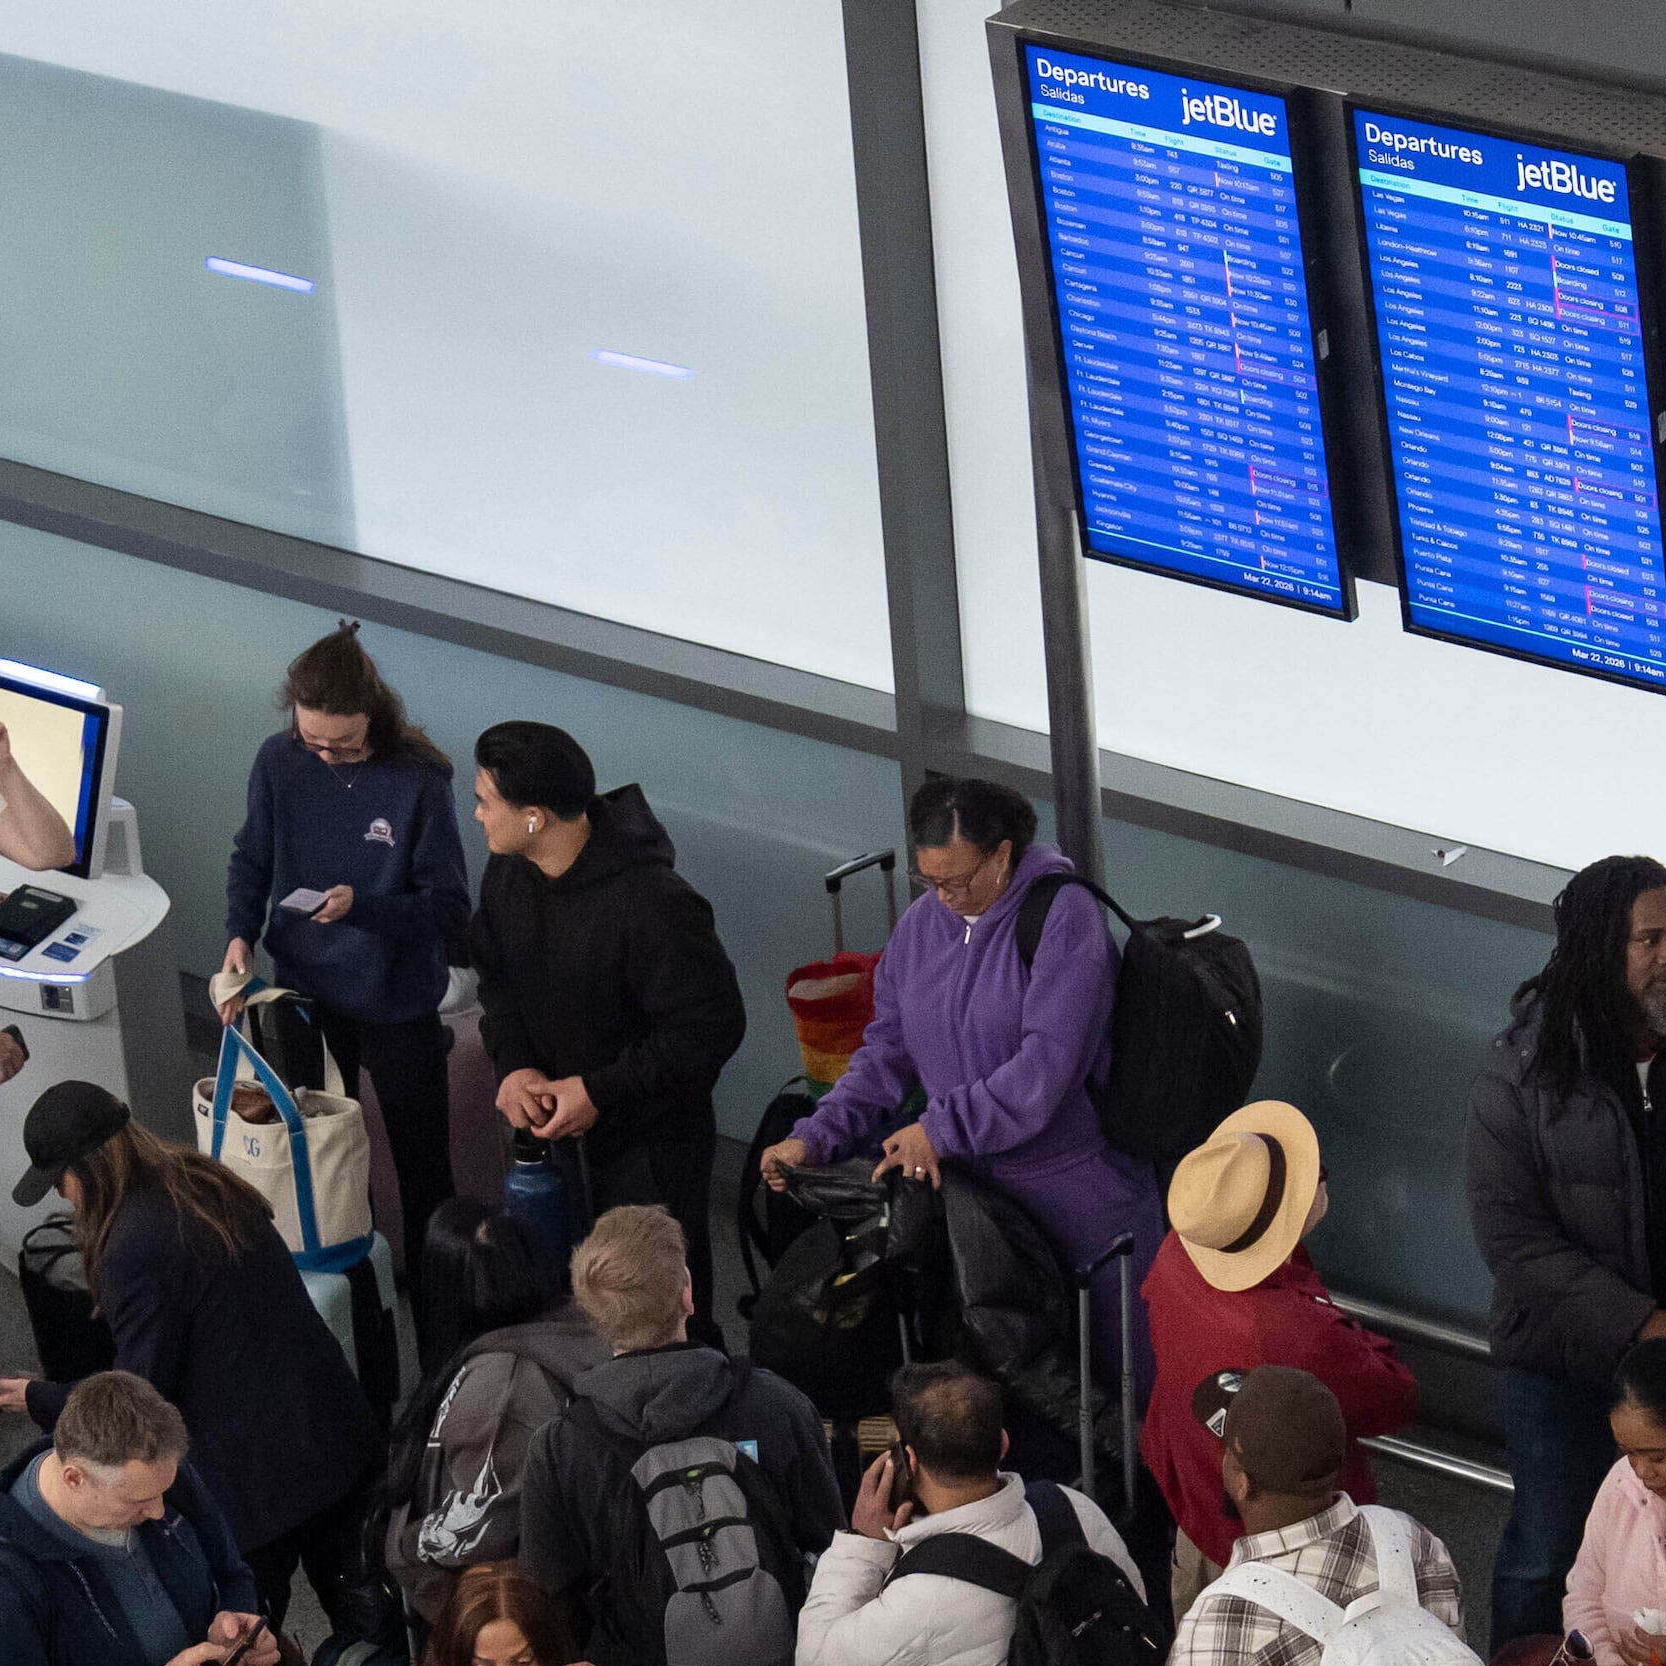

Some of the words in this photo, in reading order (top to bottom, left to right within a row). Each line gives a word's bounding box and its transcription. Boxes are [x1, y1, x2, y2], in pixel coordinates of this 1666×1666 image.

[1036, 57, 1149, 99] Departures
[1040, 83, 1084, 104] Salidas
[1181, 87, 1275, 136] jetBlue
[1365, 122, 1483, 165] Departures
[1368, 148, 1414, 170] Salidas
[1516, 153, 1614, 202] jetBlue
[1557, 290, 1578, 302] Doors
[1579, 297, 1603, 309] closing
[1571, 418, 1591, 429] Doors
[1591, 424, 1616, 436] closing
[1243, 571, 1259, 582] Mar
[1260, 575, 1273, 587] 22,
[1275, 579, 1294, 591] 2026
[1302, 586, 1332, 600] 9:14am
[1571, 647, 1588, 658] Mar
[1590, 652, 1603, 664] 22,
[1604, 655, 1625, 668] 2026
[1634, 662, 1664, 677] 9:14am
